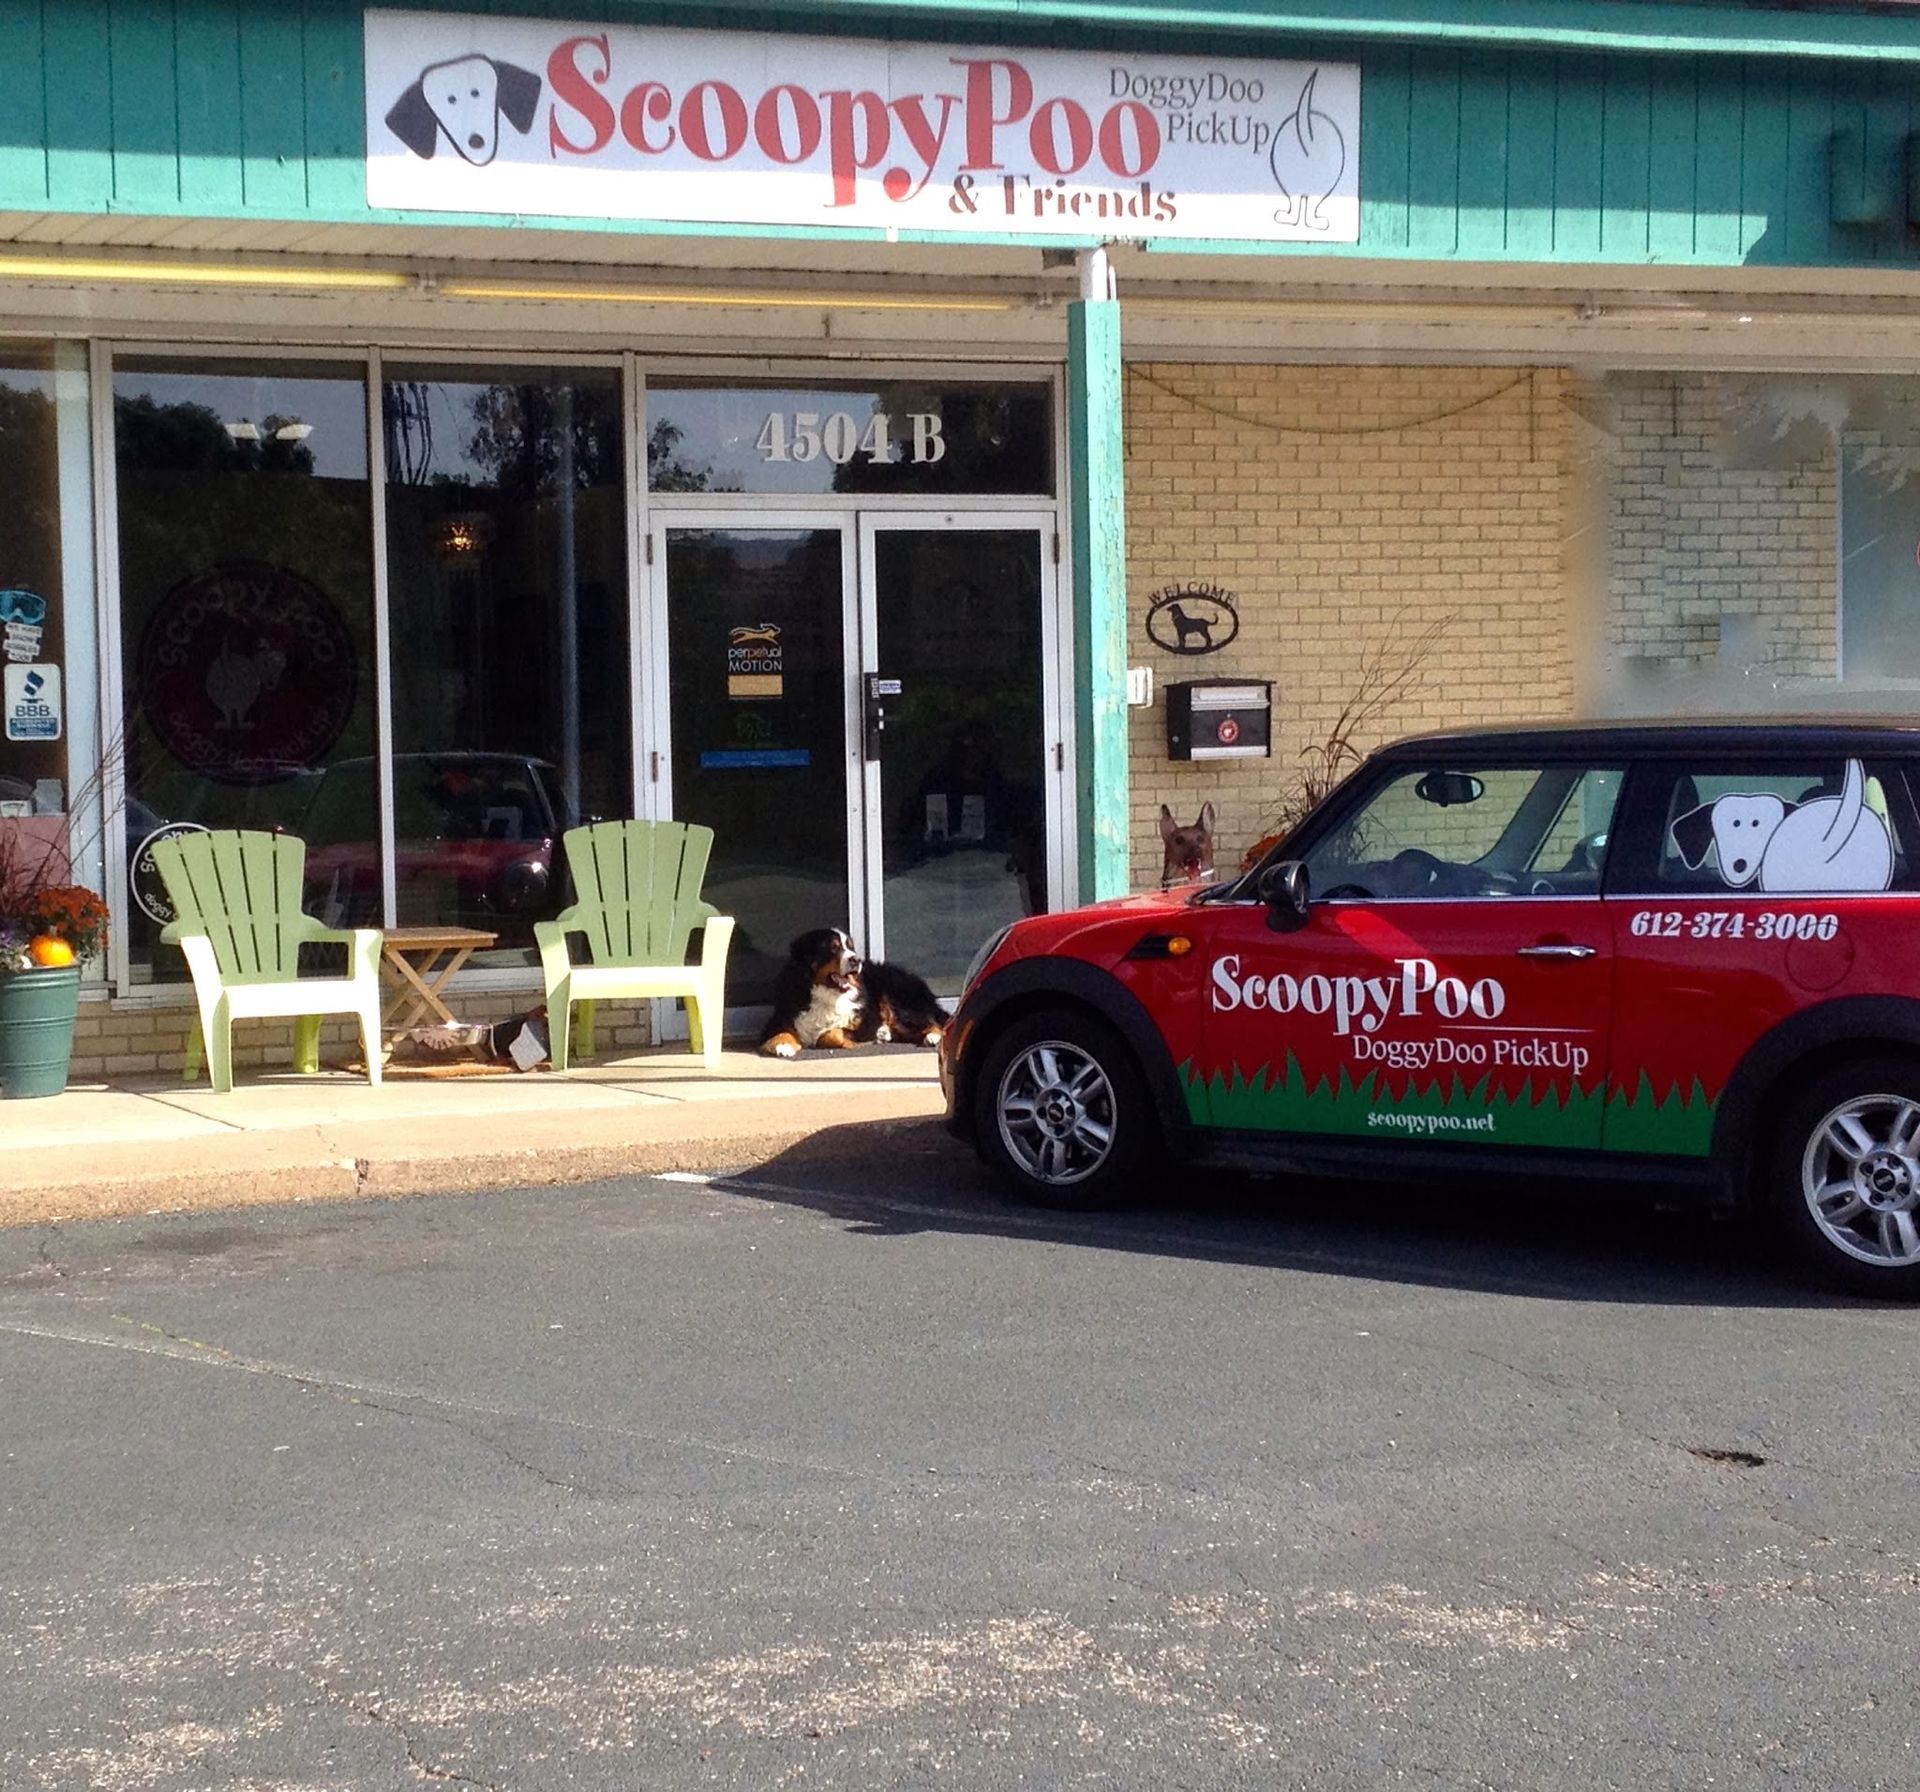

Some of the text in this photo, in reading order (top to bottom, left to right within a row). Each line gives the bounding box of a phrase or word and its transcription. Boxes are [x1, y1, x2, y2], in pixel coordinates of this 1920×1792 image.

[1110, 67, 1265, 109] DoggyDoo
[546, 33, 1161, 208] ScoopyPoo
[1166, 112, 1270, 154] PickUp
[949, 173, 1178, 222] & Friends
[755, 411, 946, 465] 4504 B
[1148, 581, 1239, 606] WELCOME
[728, 660, 783, 672] MOTION
[15, 705, 50, 717] BBB
[1630, 911, 1839, 941] 612-374-3000
[1211, 953, 1506, 1036] ScoopyPoo
[1353, 1034, 1589, 1075] DoggyDoo PickUp
[1367, 1111, 1496, 1134] scoopypoo.net
